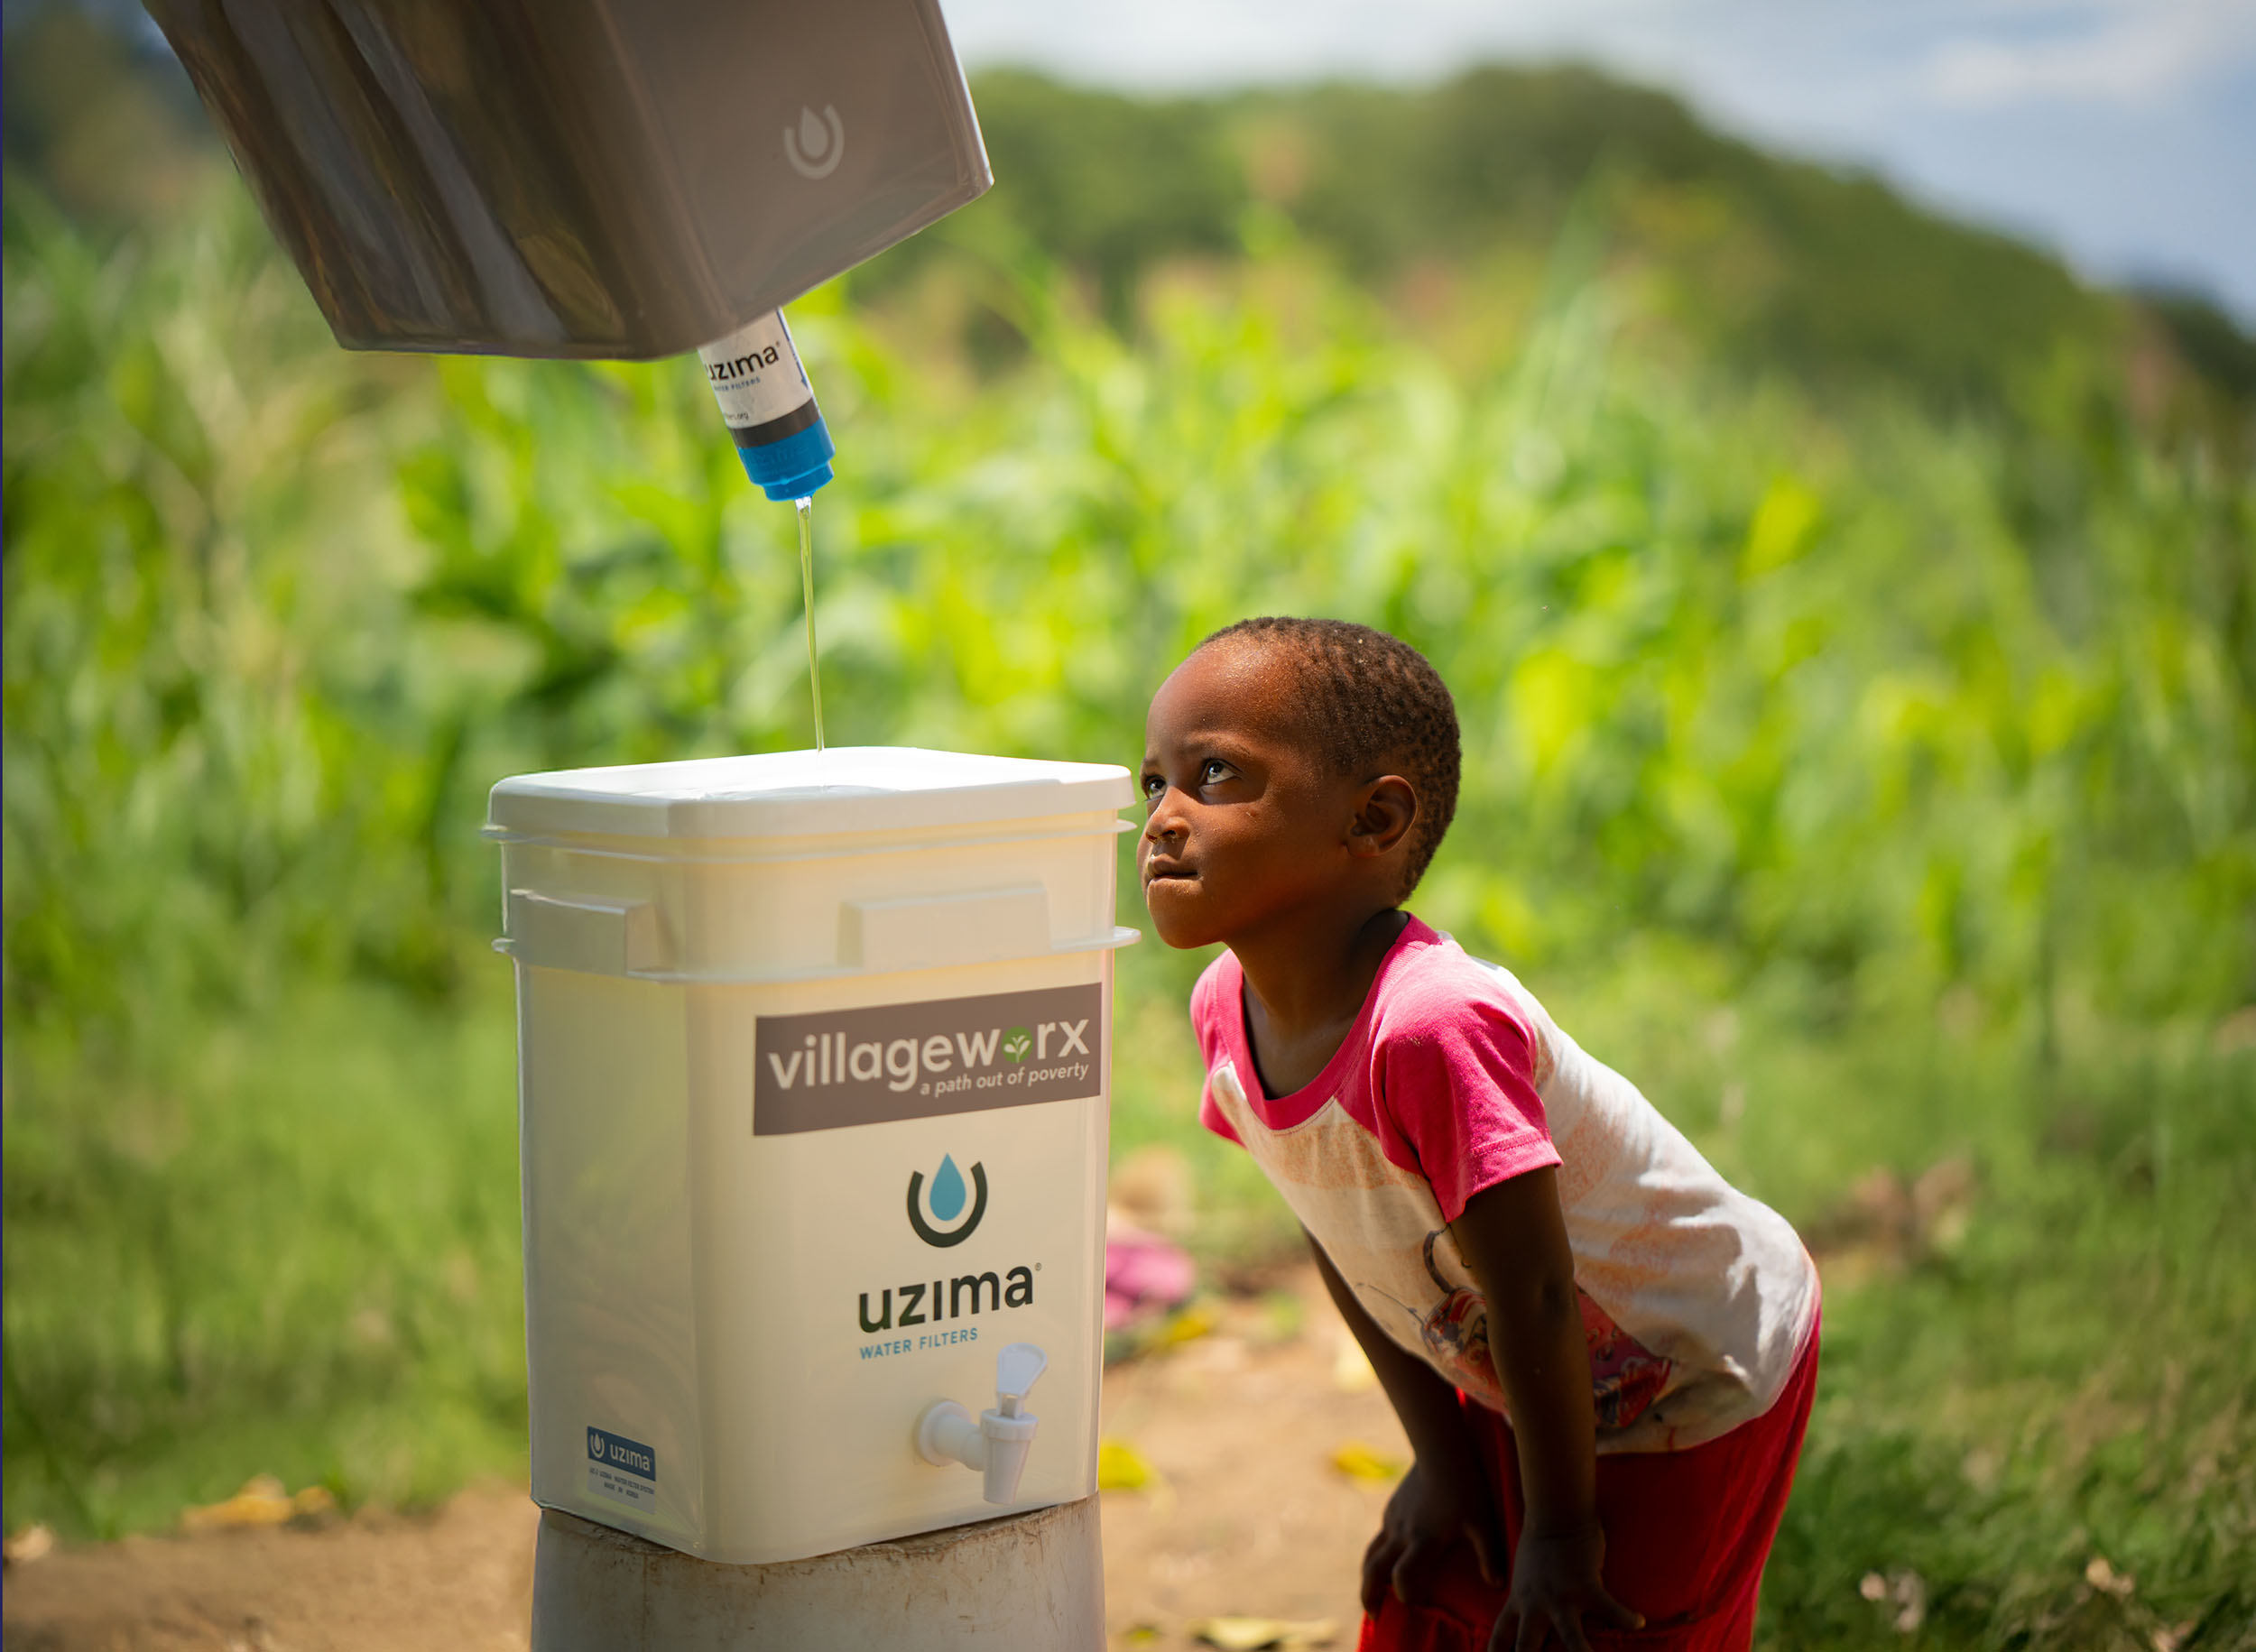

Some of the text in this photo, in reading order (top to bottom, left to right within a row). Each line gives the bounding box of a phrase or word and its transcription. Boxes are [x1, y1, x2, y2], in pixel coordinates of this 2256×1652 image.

[920, 1061, 1089, 1098] a path out of poverty
[859, 1327, 978, 1361] WATER FILTERS
